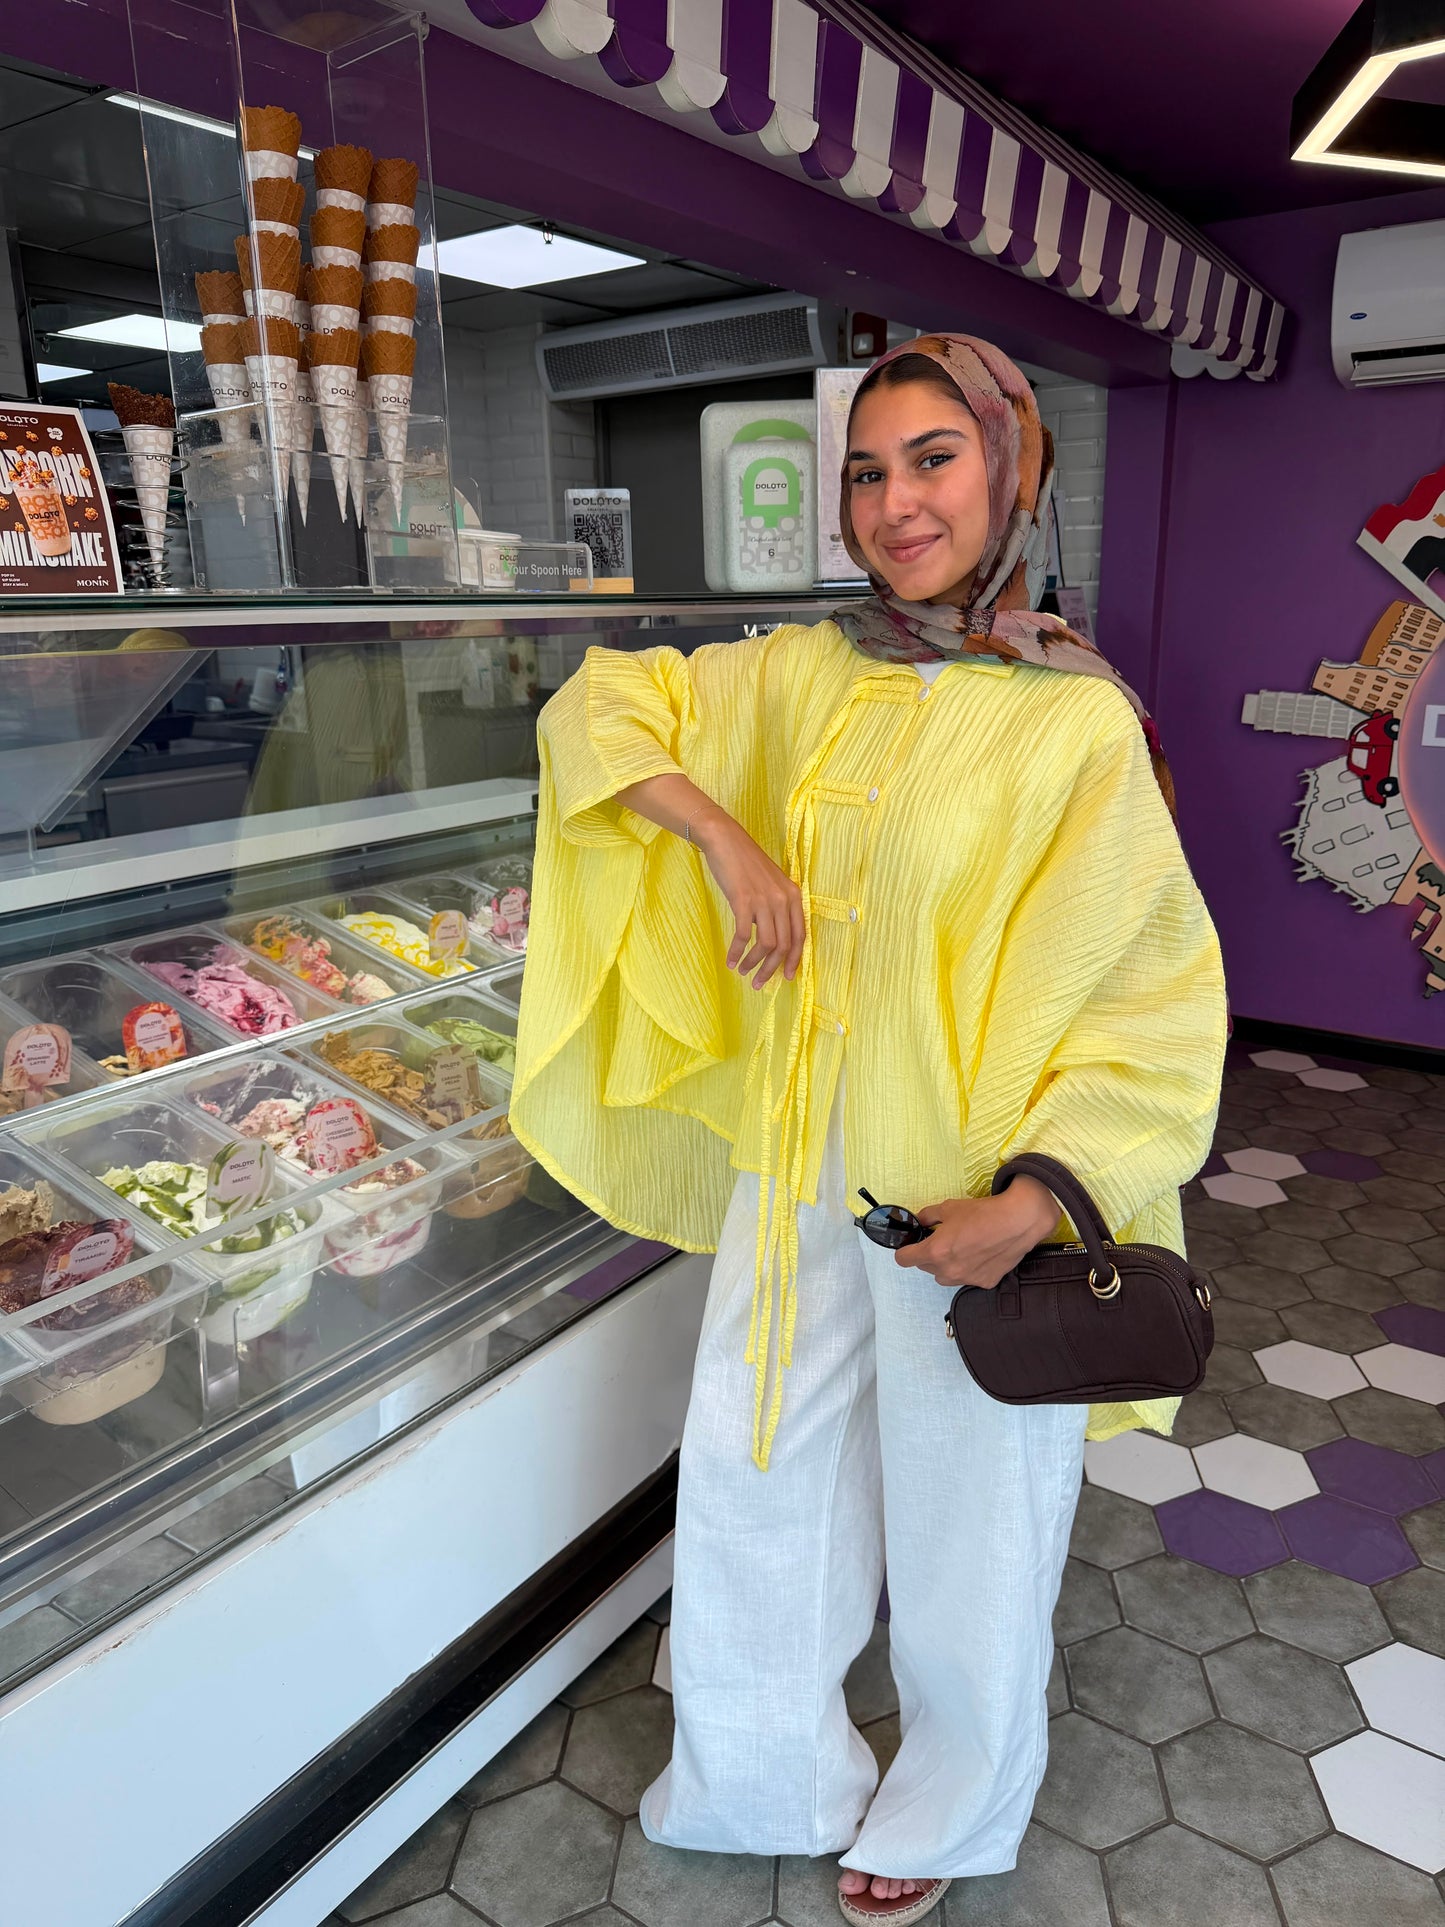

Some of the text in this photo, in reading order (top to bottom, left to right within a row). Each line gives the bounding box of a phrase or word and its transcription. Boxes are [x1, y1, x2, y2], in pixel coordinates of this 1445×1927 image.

[768, 548, 775, 557] 6
[530, 563, 559, 578] Spoon
[561, 564, 582, 576] Here
[230, 1160, 255, 1170] DOLOTO
